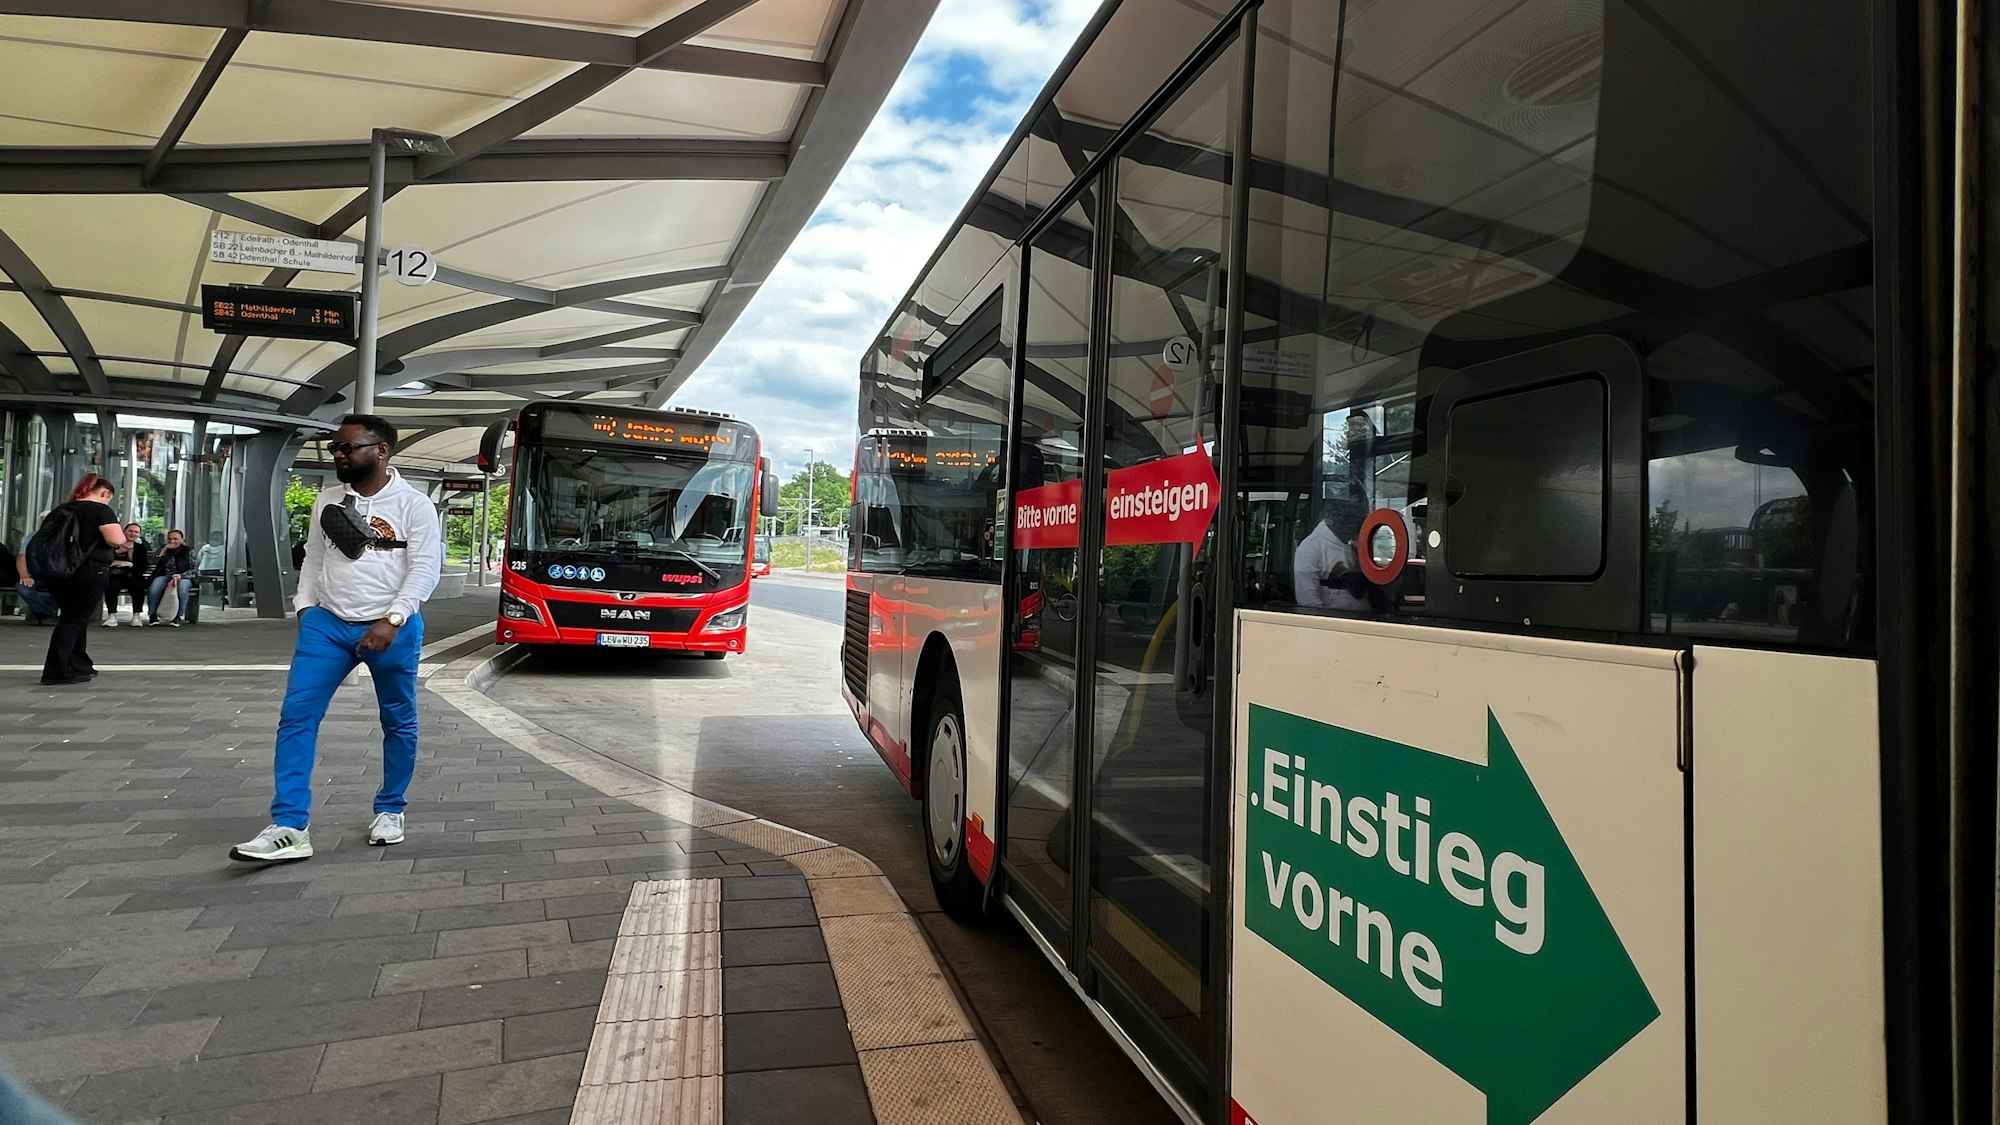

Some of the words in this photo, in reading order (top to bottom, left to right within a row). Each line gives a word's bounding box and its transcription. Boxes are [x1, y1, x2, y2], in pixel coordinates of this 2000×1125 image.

[213, 231, 230, 240] 212
[240, 234, 275, 245] Edelrath
[282, 238, 319, 248] Odenthal
[212, 241, 226, 250] SB
[227, 243, 239, 251] 22
[240, 244, 287, 255] Leimbacher
[304, 250, 354, 262] Mathildenhof
[212, 250, 225, 259] SB
[227, 252, 238, 260] 42
[282, 257, 311, 267] Schule
[391, 249, 428, 278] 12
[213, 301, 235, 310] SB22
[240, 303, 297, 316] Mathildenhof
[314, 308, 321, 316] 3
[323, 309, 340, 318] Min
[213, 308, 235, 317] SB42
[240, 310, 279, 320] Odenthal
[323, 316, 340, 325] Min
[1109, 479, 1209, 522] einsteigen
[1016, 504, 1041, 529] Bitte
[1042, 502, 1077, 528] vorne
[511, 560, 527, 571] 235
[661, 571, 703, 586] wupsi
[600, 608, 651, 621] MAN
[634, 636, 648, 645] 235
[1261, 850, 1444, 1007] vorne
